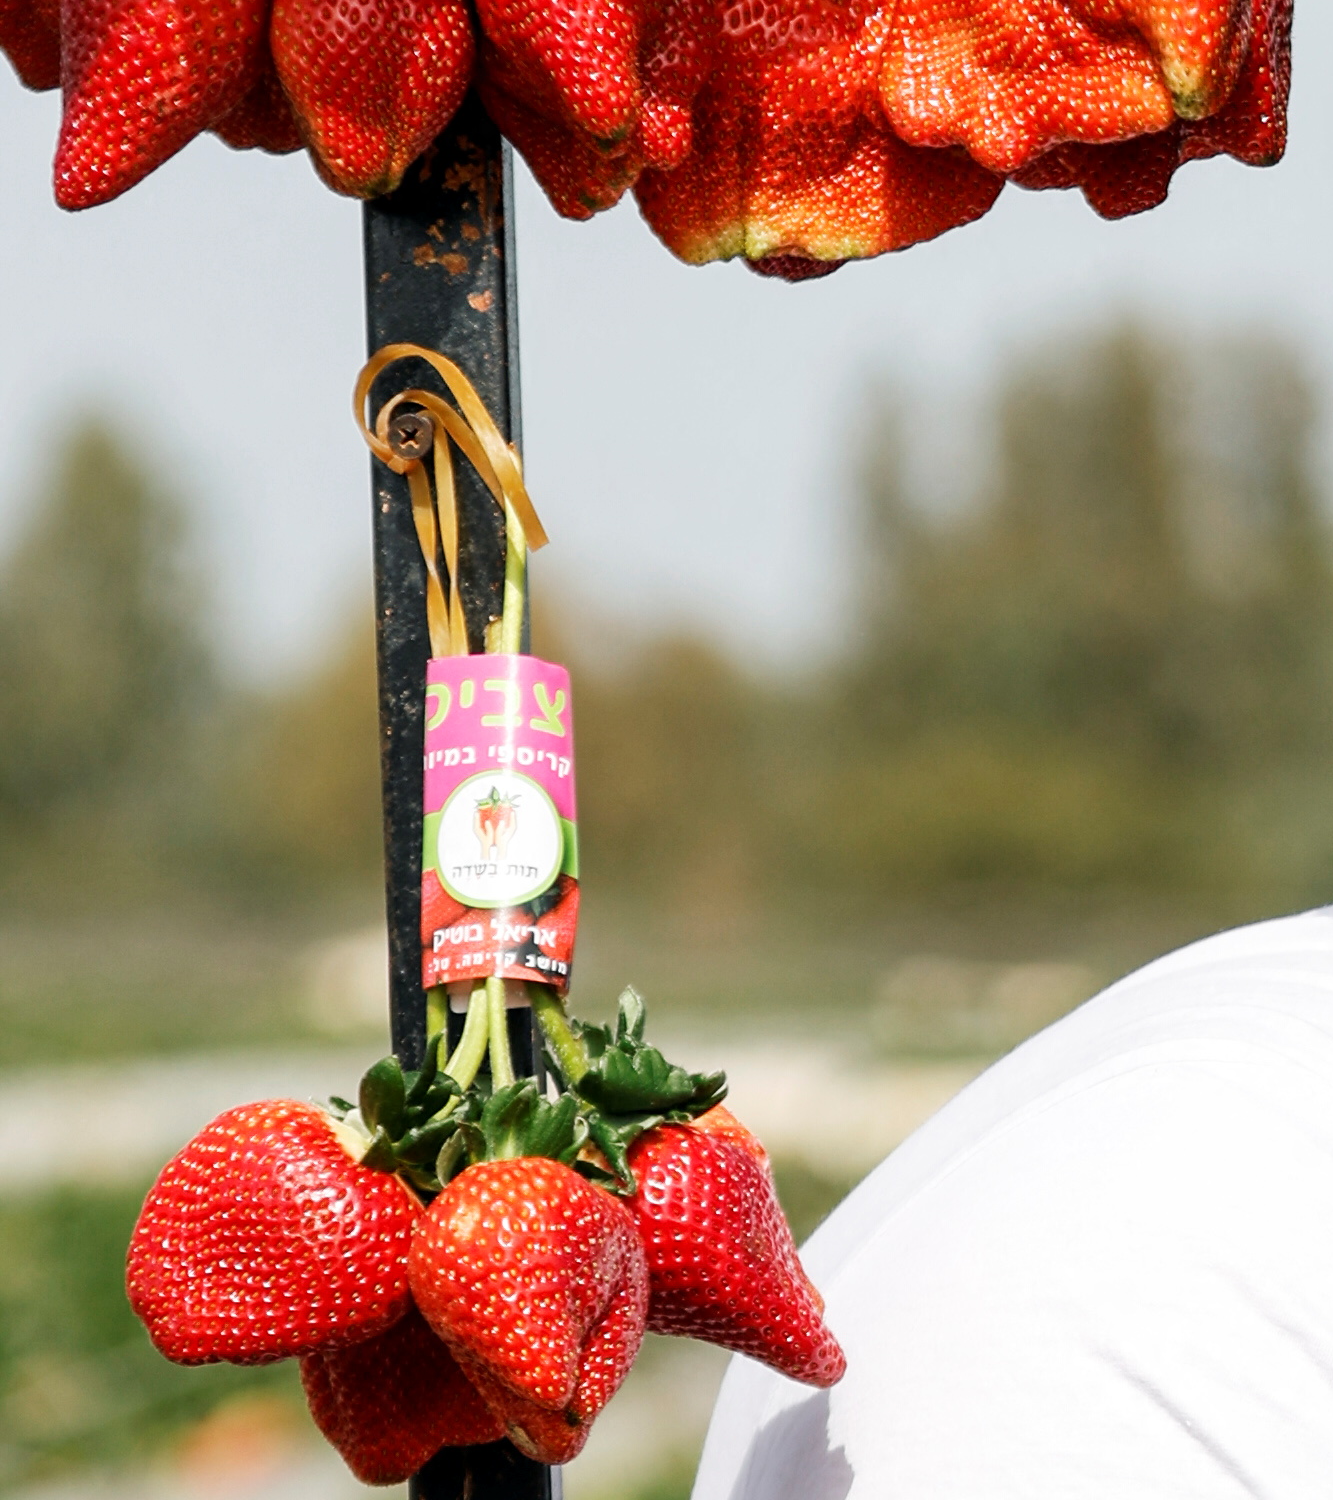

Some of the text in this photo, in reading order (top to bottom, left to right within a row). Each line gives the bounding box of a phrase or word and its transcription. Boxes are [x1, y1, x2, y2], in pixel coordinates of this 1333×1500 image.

[488, 744, 571, 778] קריספי
[507, 865, 539, 879] תות
[432, 918, 557, 953] אריאל בוטיק
[525, 954, 568, 976] מושב
